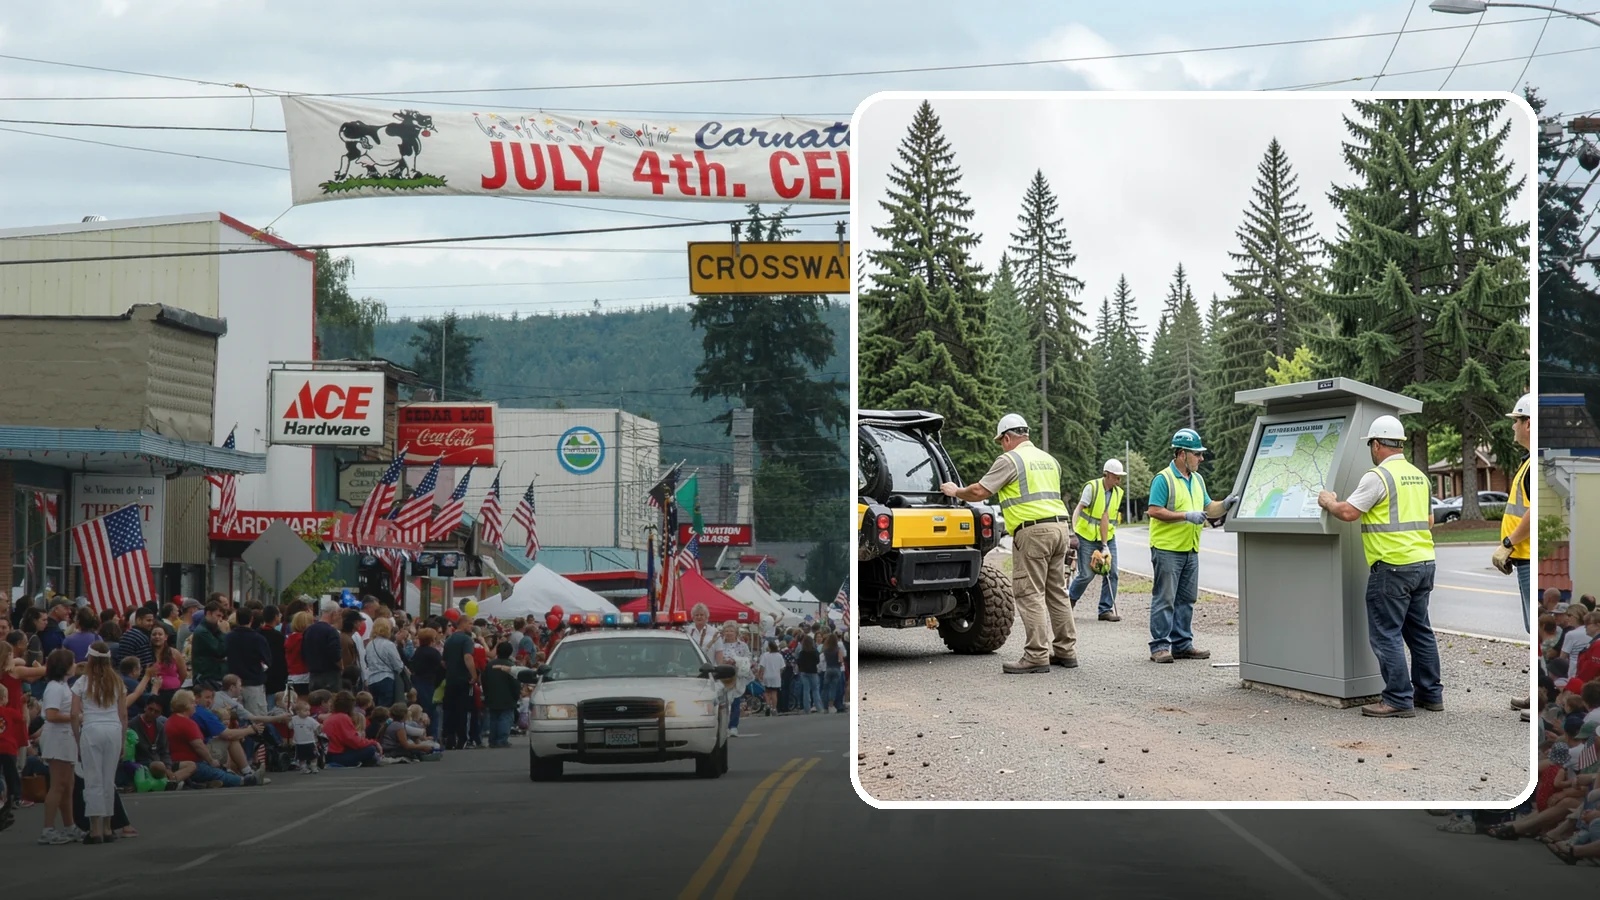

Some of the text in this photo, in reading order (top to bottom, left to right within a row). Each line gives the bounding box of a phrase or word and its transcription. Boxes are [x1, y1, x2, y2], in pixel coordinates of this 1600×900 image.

[481, 140, 605, 192] JULY
[632, 149, 747, 198] 4th.
[697, 254, 850, 280] CROSSWA
[282, 380, 374, 420] ACE
[405, 409, 452, 422] CEDAR
[283, 421, 370, 436] Hardware
[353, 467, 384, 480] Simpl
[96, 485, 124, 495] Vincent
[126, 485, 135, 495] de
[137, 485, 155, 495] Paul
[688, 526, 741, 535] CRNATION
[699, 535, 730, 543] GLASS
